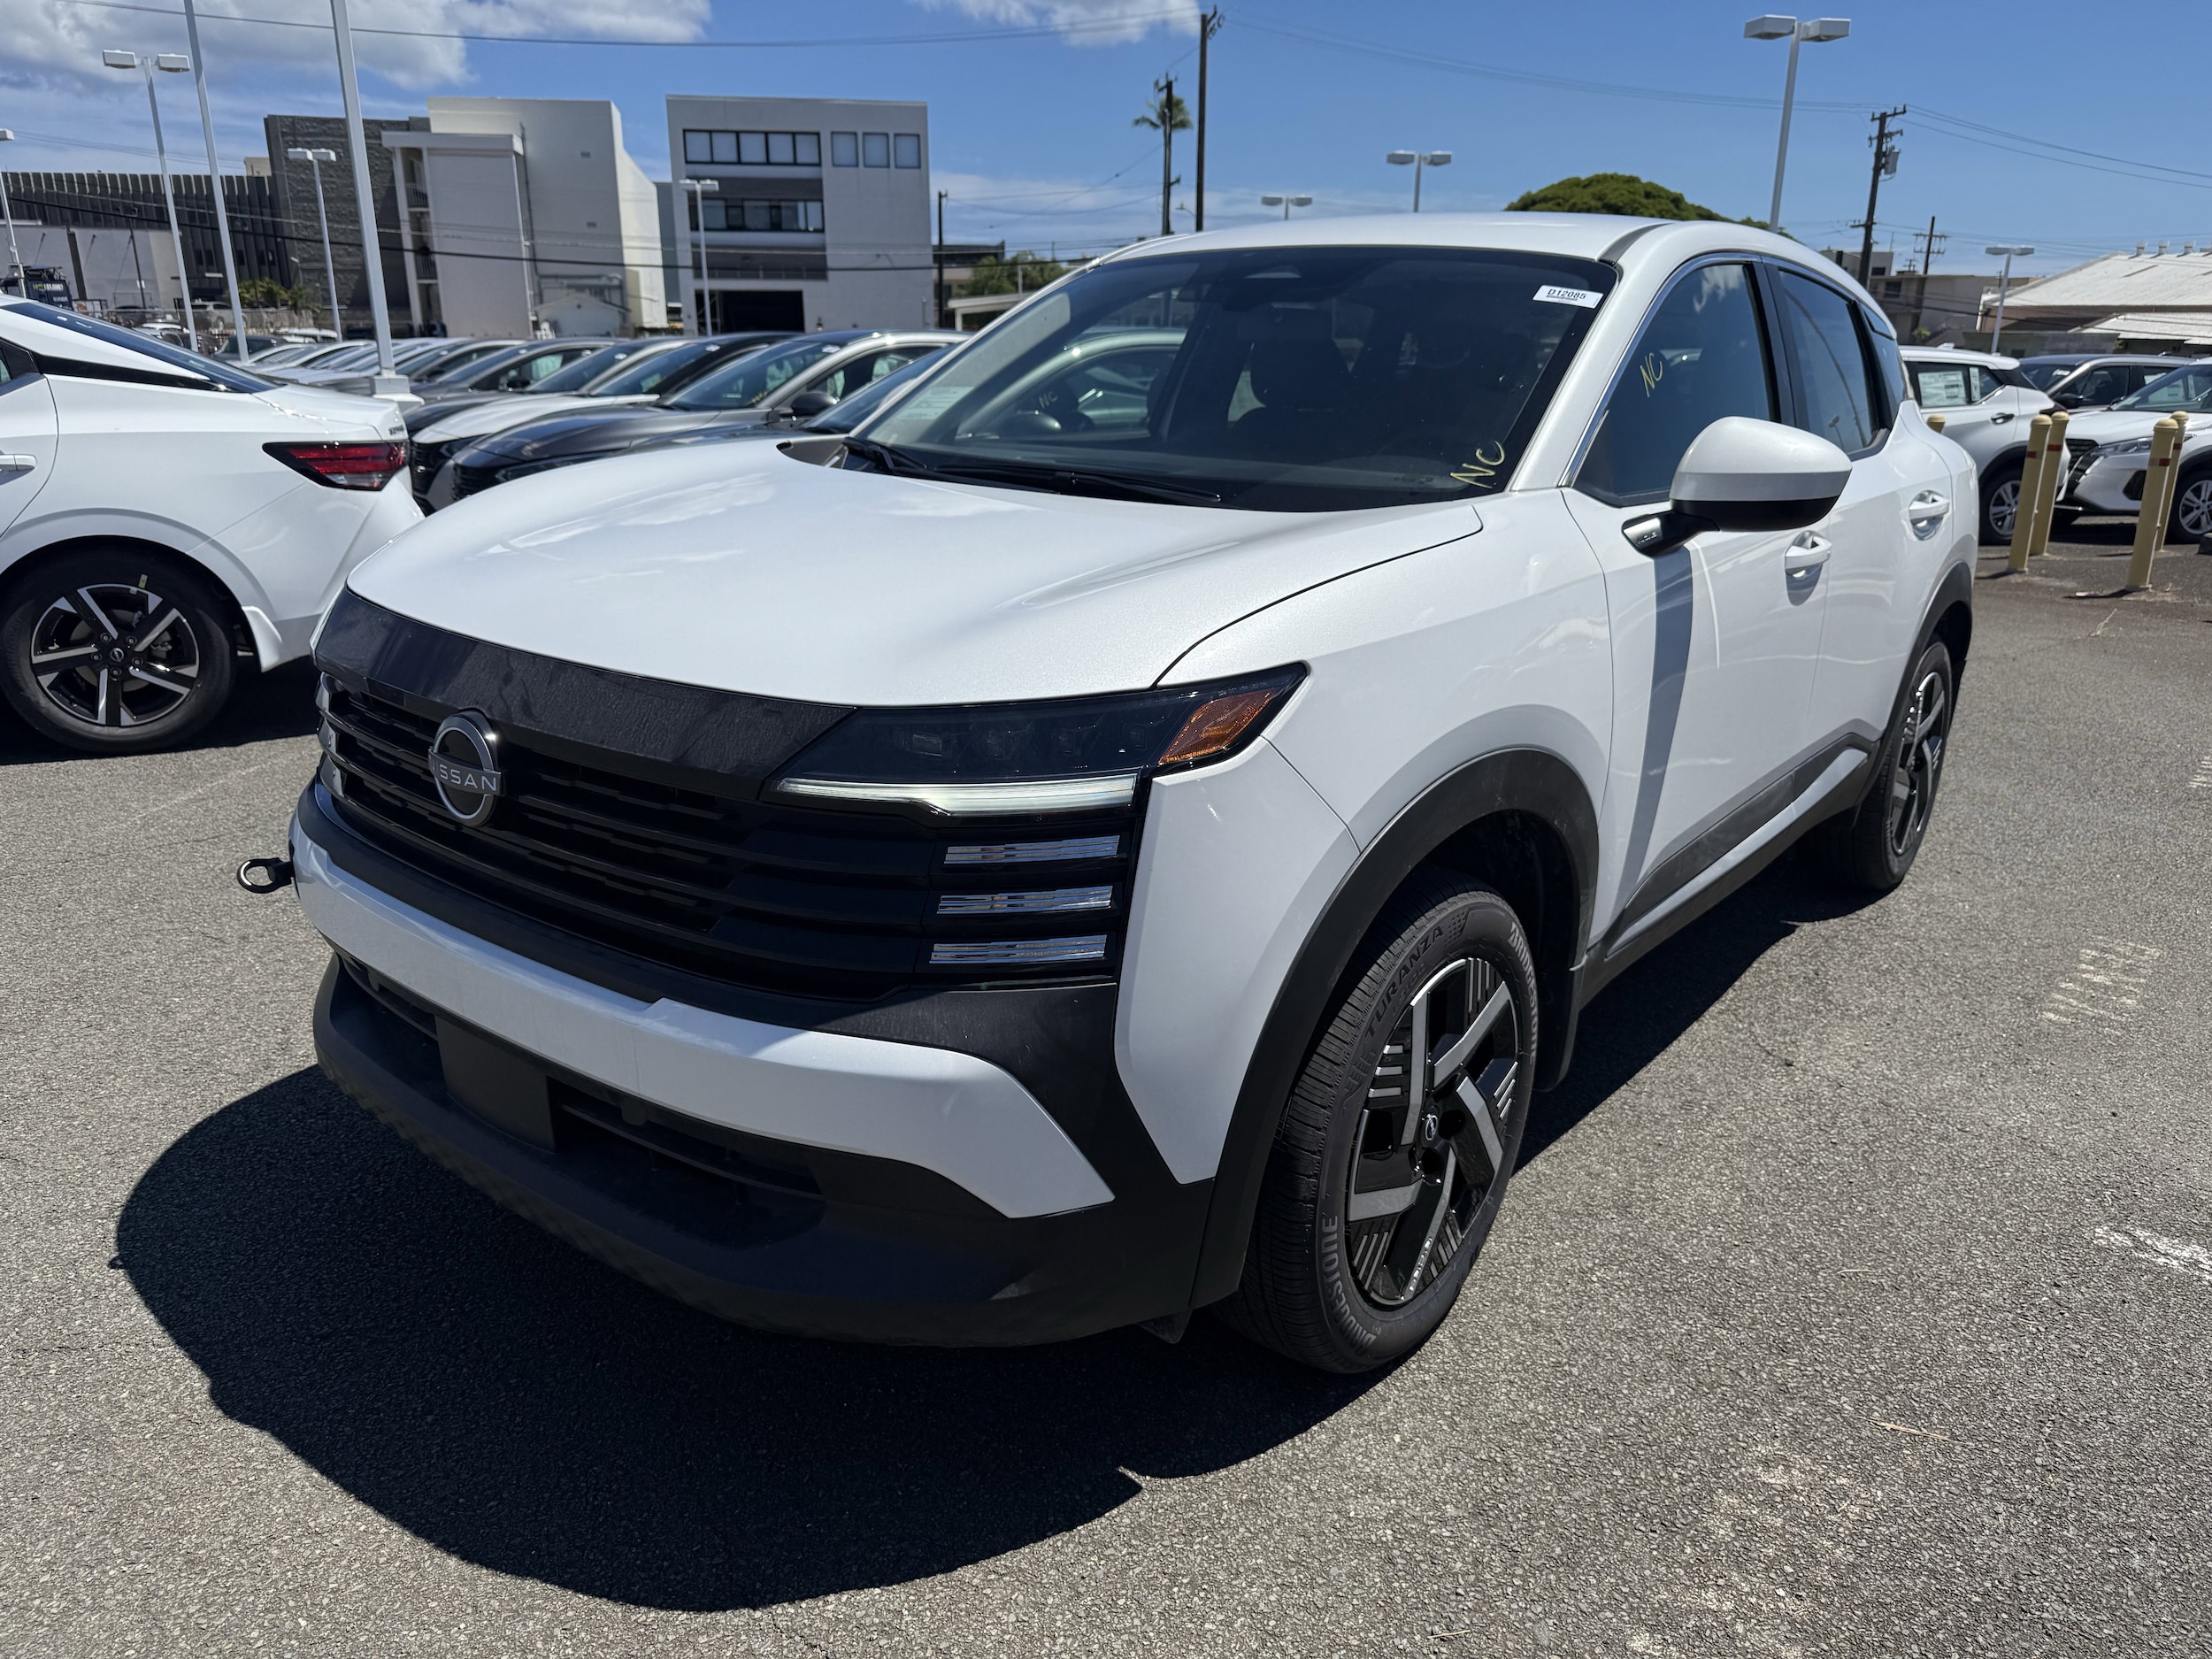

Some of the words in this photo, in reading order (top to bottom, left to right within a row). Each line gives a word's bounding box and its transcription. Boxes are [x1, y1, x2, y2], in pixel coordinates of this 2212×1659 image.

[1640, 352, 1663, 398] NC
[1450, 441, 1505, 489] NC
[429, 755, 496, 791] SSAN
[1364, 926, 1444, 1038] TURANZA
